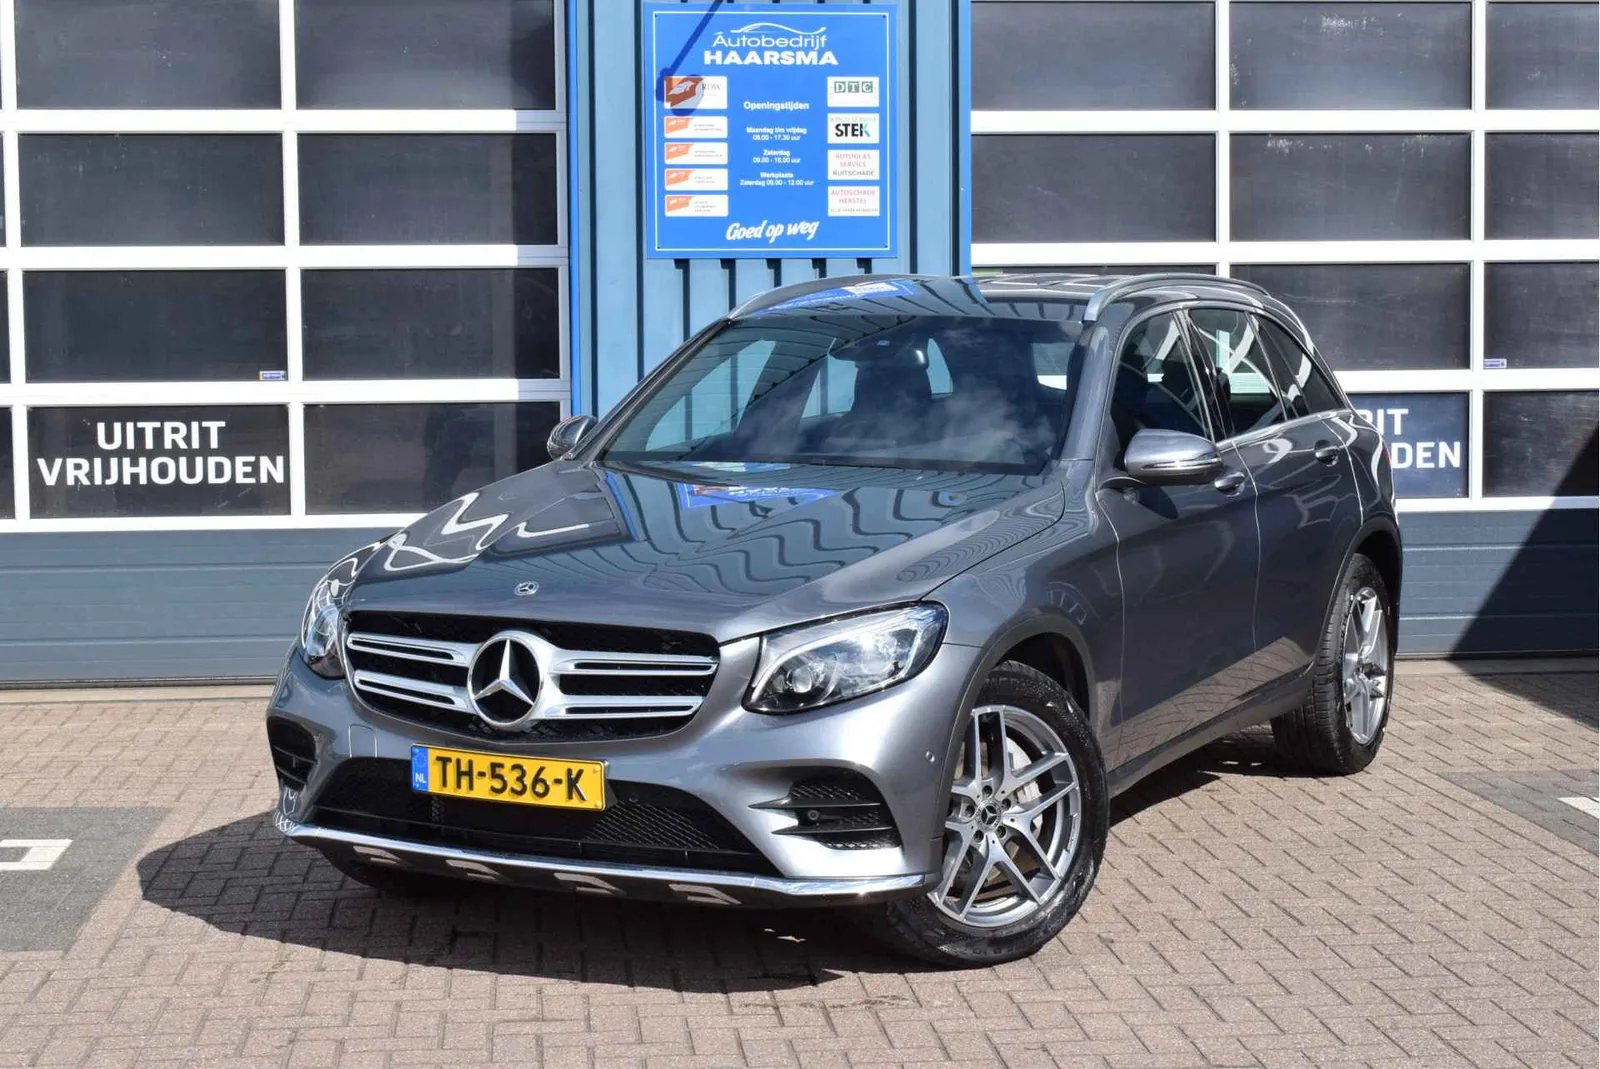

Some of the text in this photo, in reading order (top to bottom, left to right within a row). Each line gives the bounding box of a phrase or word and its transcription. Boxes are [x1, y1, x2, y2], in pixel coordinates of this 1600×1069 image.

[712, 34, 828, 50] Autobedrijf
[704, 50, 840, 65] HAARSMA
[743, 101, 810, 111] Openingstijden
[835, 123, 871, 137] STEK
[726, 219, 820, 244] Goed op weg
[97, 421, 226, 450] UITRIT
[36, 456, 285, 485] VRIJHOUDEN
[415, 755, 588, 802] NL TH-536-K
